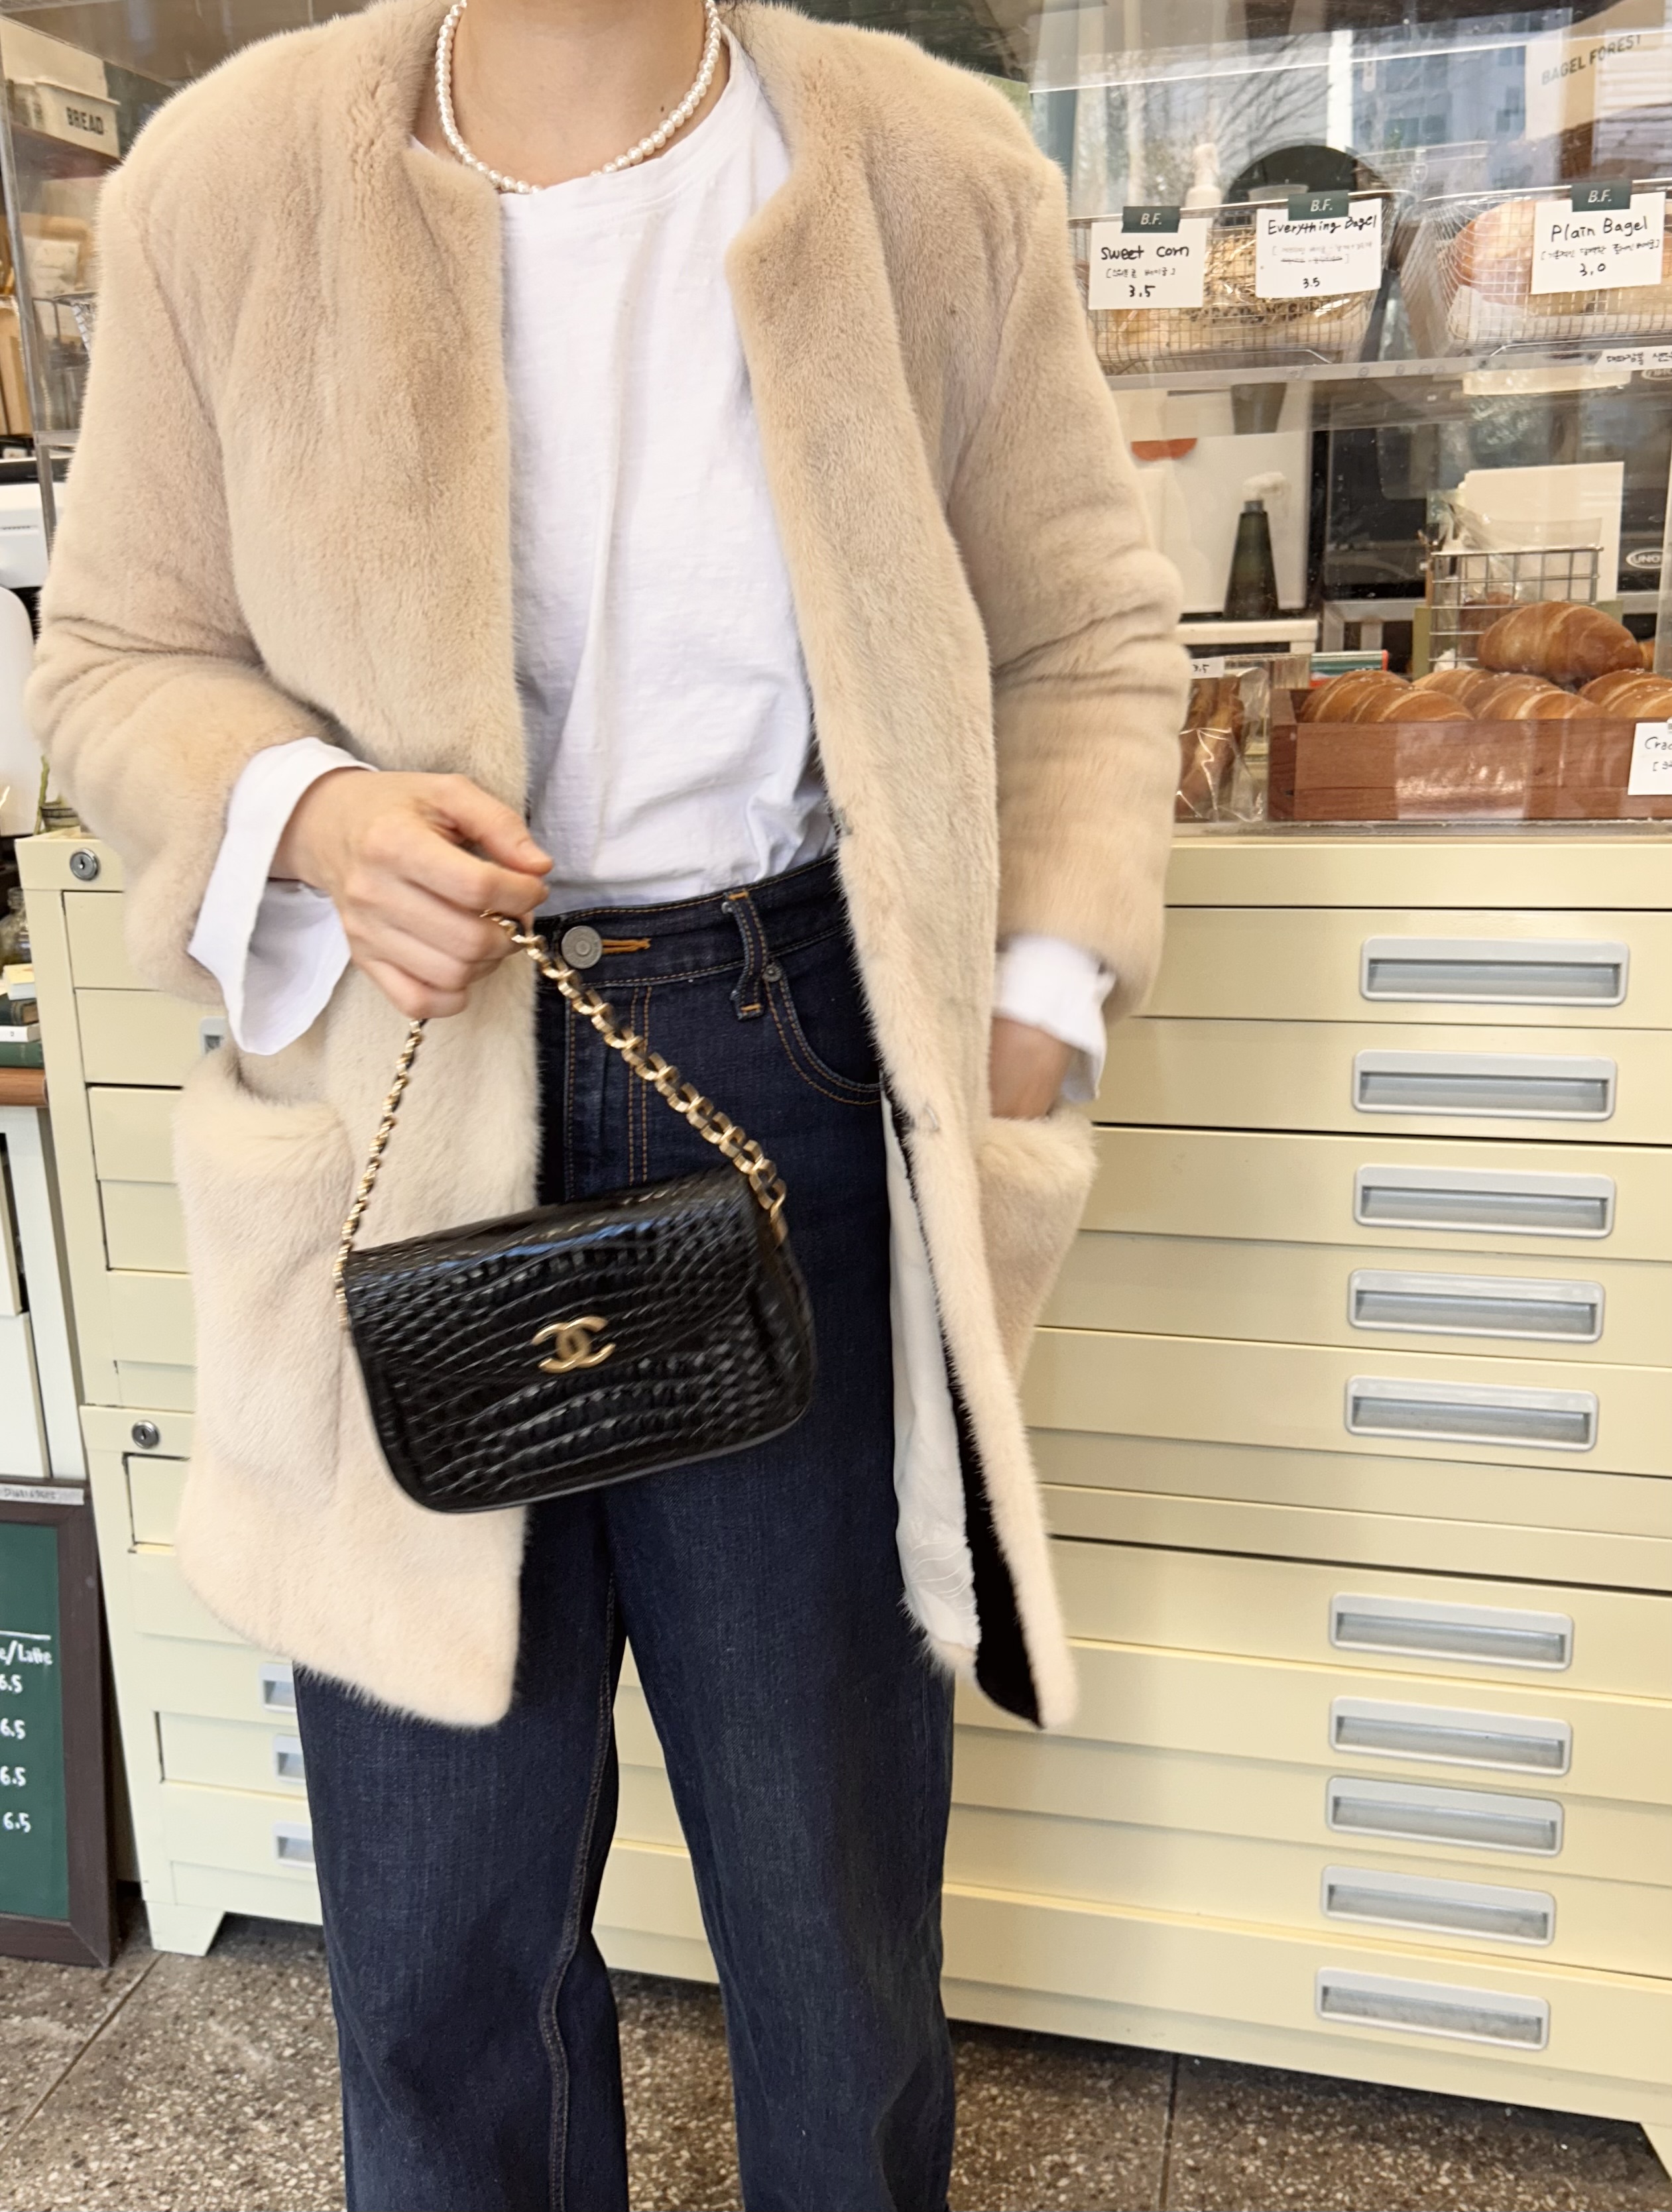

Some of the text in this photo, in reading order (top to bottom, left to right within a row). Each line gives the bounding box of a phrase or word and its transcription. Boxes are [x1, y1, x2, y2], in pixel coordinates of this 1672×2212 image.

[1541, 34, 1642, 85] BAGEL FOREST
[66, 107, 104, 135] BREAD
[1310, 199, 1333, 212] B.F.
[1588, 189, 1612, 203] B.F.
[1140, 213, 1162, 225] B.F.
[1268, 214, 1377, 235] Everything Bagel
[1551, 215, 1648, 243] Plain Bagel
[1129, 284, 1156, 297] 3.5
[1302, 277, 1321, 289] 3.5
[0, 1674, 23, 1694] 6.5
[0, 1717, 26, 1740] 6.5
[0, 1765, 27, 1787] 6.5
[3, 1811, 32, 1834] 6.5
